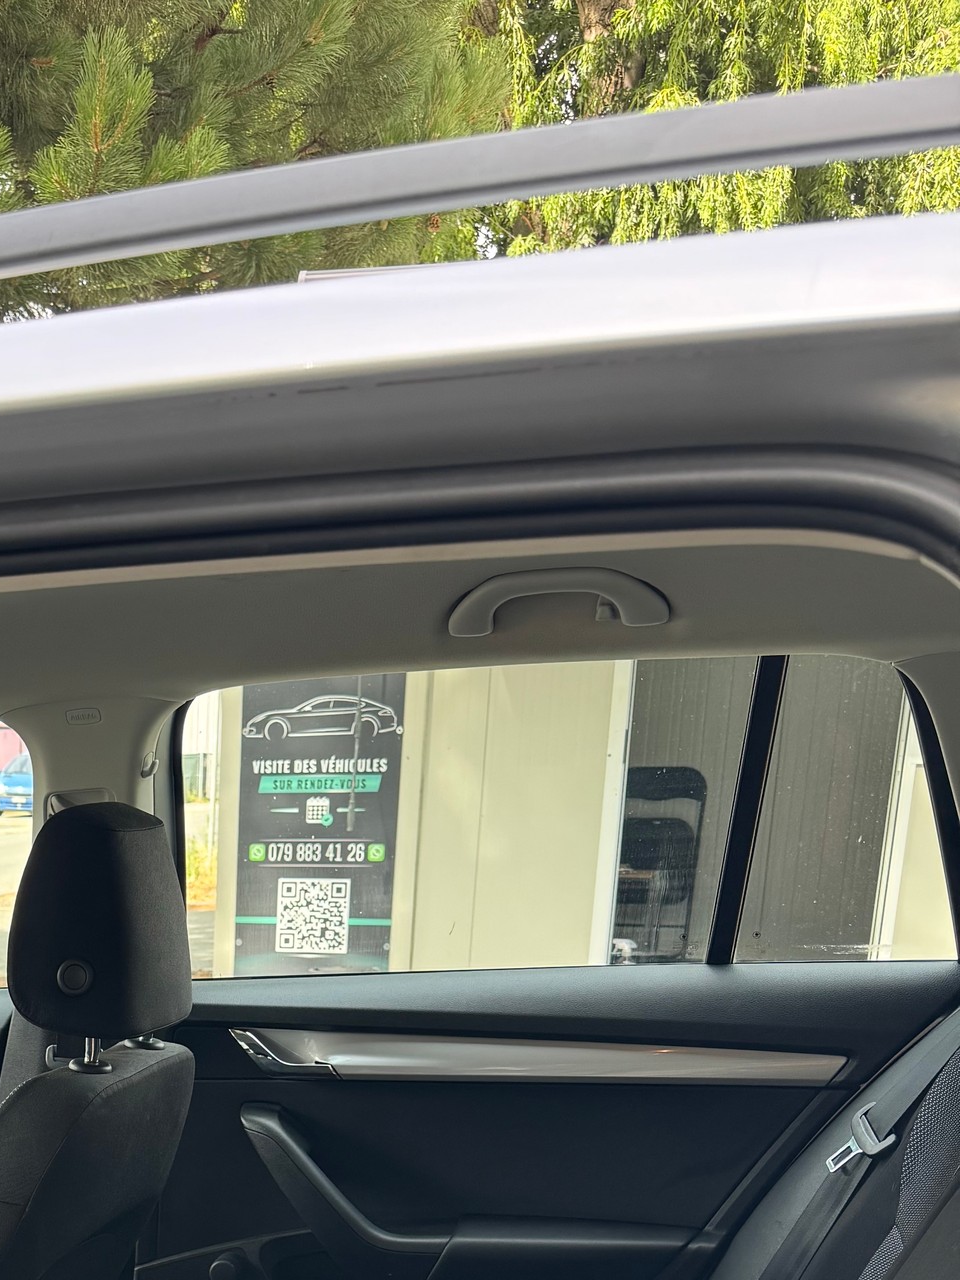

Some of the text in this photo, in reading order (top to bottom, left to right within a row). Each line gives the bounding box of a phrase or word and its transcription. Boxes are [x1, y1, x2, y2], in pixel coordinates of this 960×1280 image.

[252, 754, 389, 774] VISITE DES VÉHICULES
[272, 778, 367, 791] SUR RENDEZ-VOUS
[267, 842, 366, 862] 079 883 41 26
